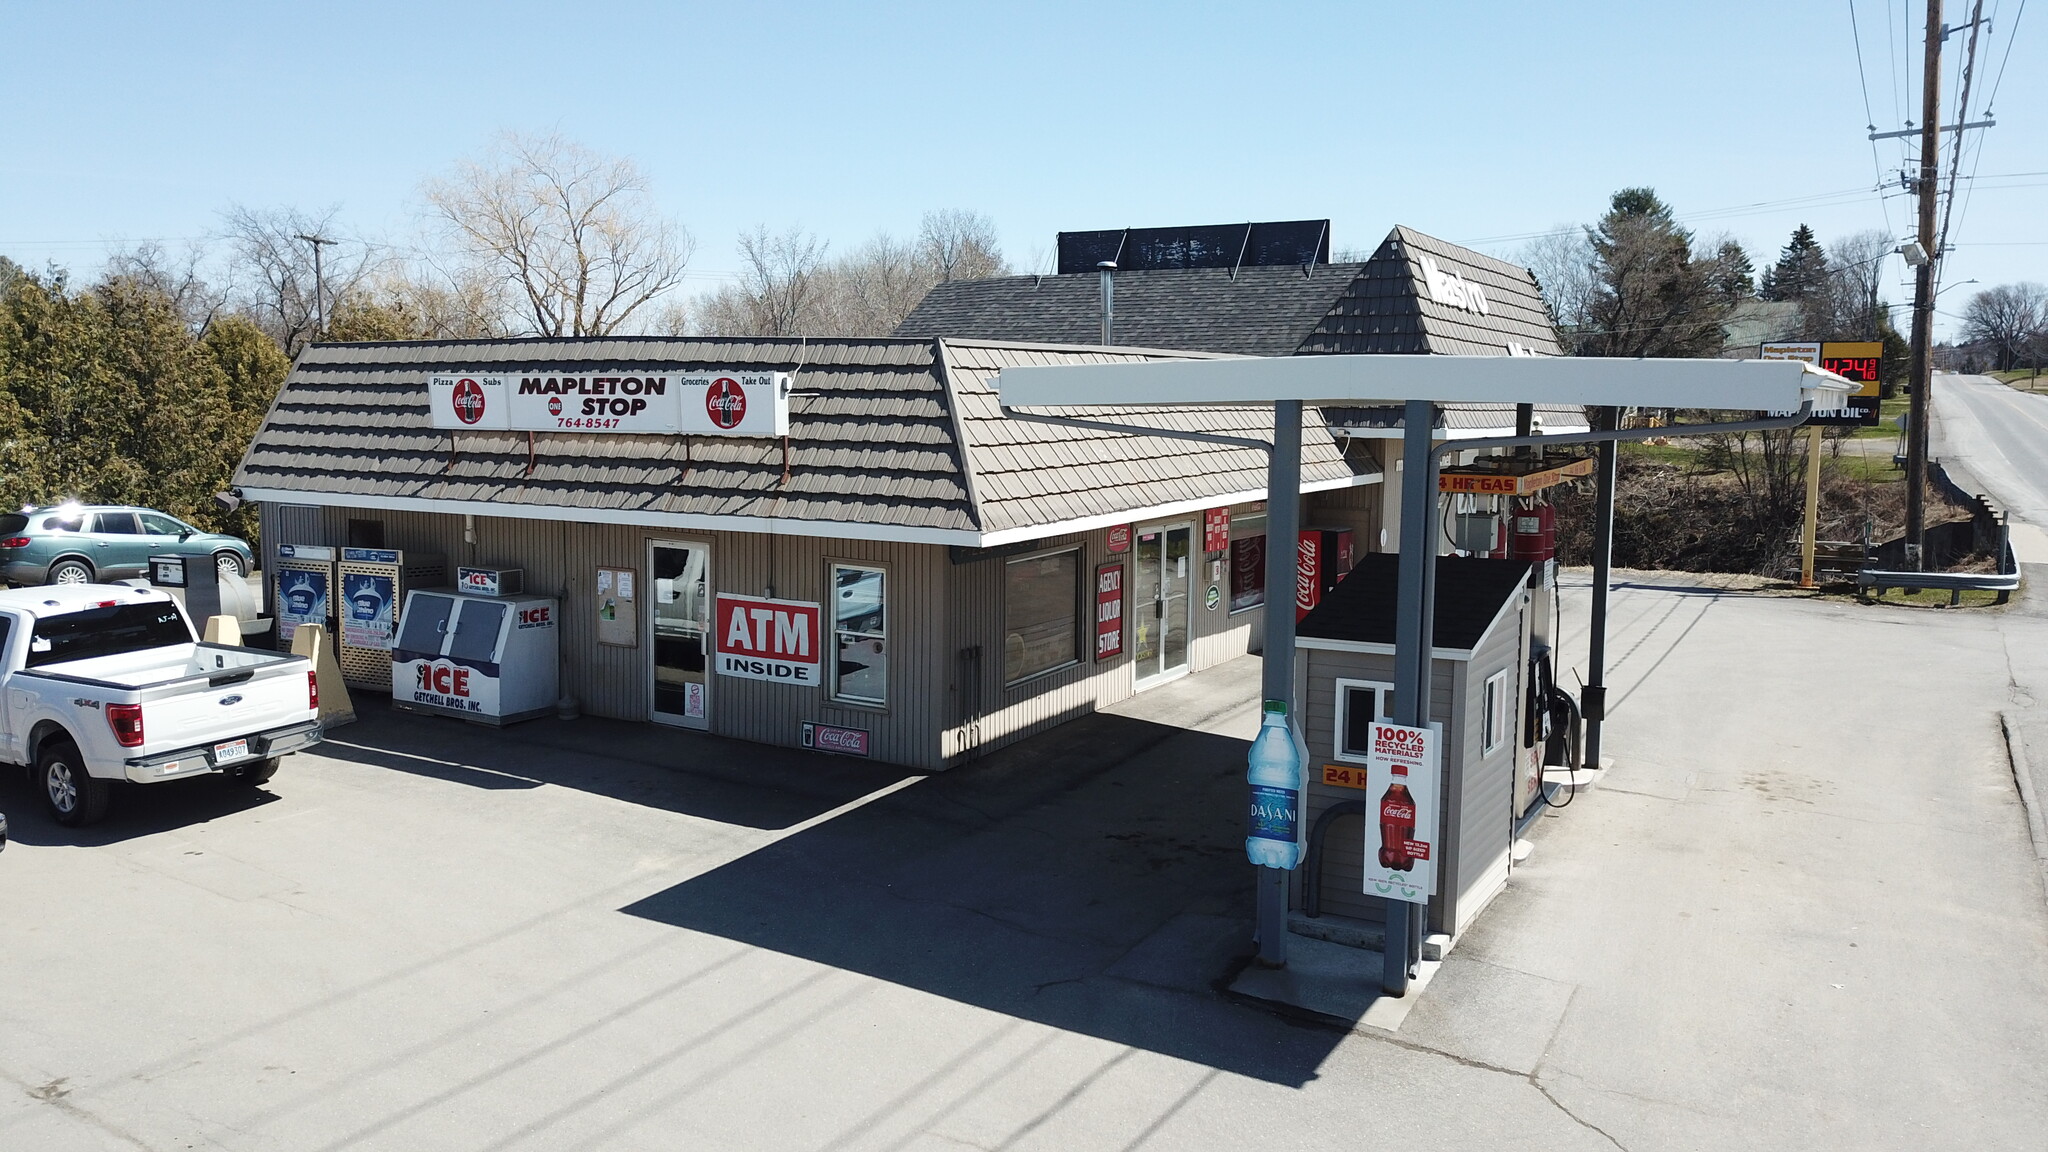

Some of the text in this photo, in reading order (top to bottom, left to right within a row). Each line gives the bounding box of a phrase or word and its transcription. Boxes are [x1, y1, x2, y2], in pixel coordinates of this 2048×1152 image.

[433, 377, 502, 386] Pizza Subs
[518, 377, 666, 395] MAPLETON
[681, 376, 771, 386] Groceries Take Out
[549, 398, 647, 416] ONE STOP
[1841, 407, 1862, 418] OIL
[557, 417, 620, 429] 764-8547
[1439, 477, 1448, 489] 4
[1480, 479, 1514, 491] GAS
[469, 572, 487, 586] ICE
[1098, 569, 1121, 594] AGENCY
[523, 606, 550, 624] ICE
[1098, 599, 1121, 623] LIQUOR
[726, 606, 810, 657] ATM
[1098, 629, 1120, 654] STORE
[726, 658, 809, 681] INSIDE
[423, 661, 470, 697] ICE
[413, 691, 482, 712] GETCHELL BROS. INC.
[1375, 726, 1424, 745] 100%
[1374, 747, 1424, 759] MATERIALS?
[1375, 739, 1424, 753] RECYCLED
[1326, 768, 1367, 786] 24 H
[1251, 802, 1296, 822] DASANI
